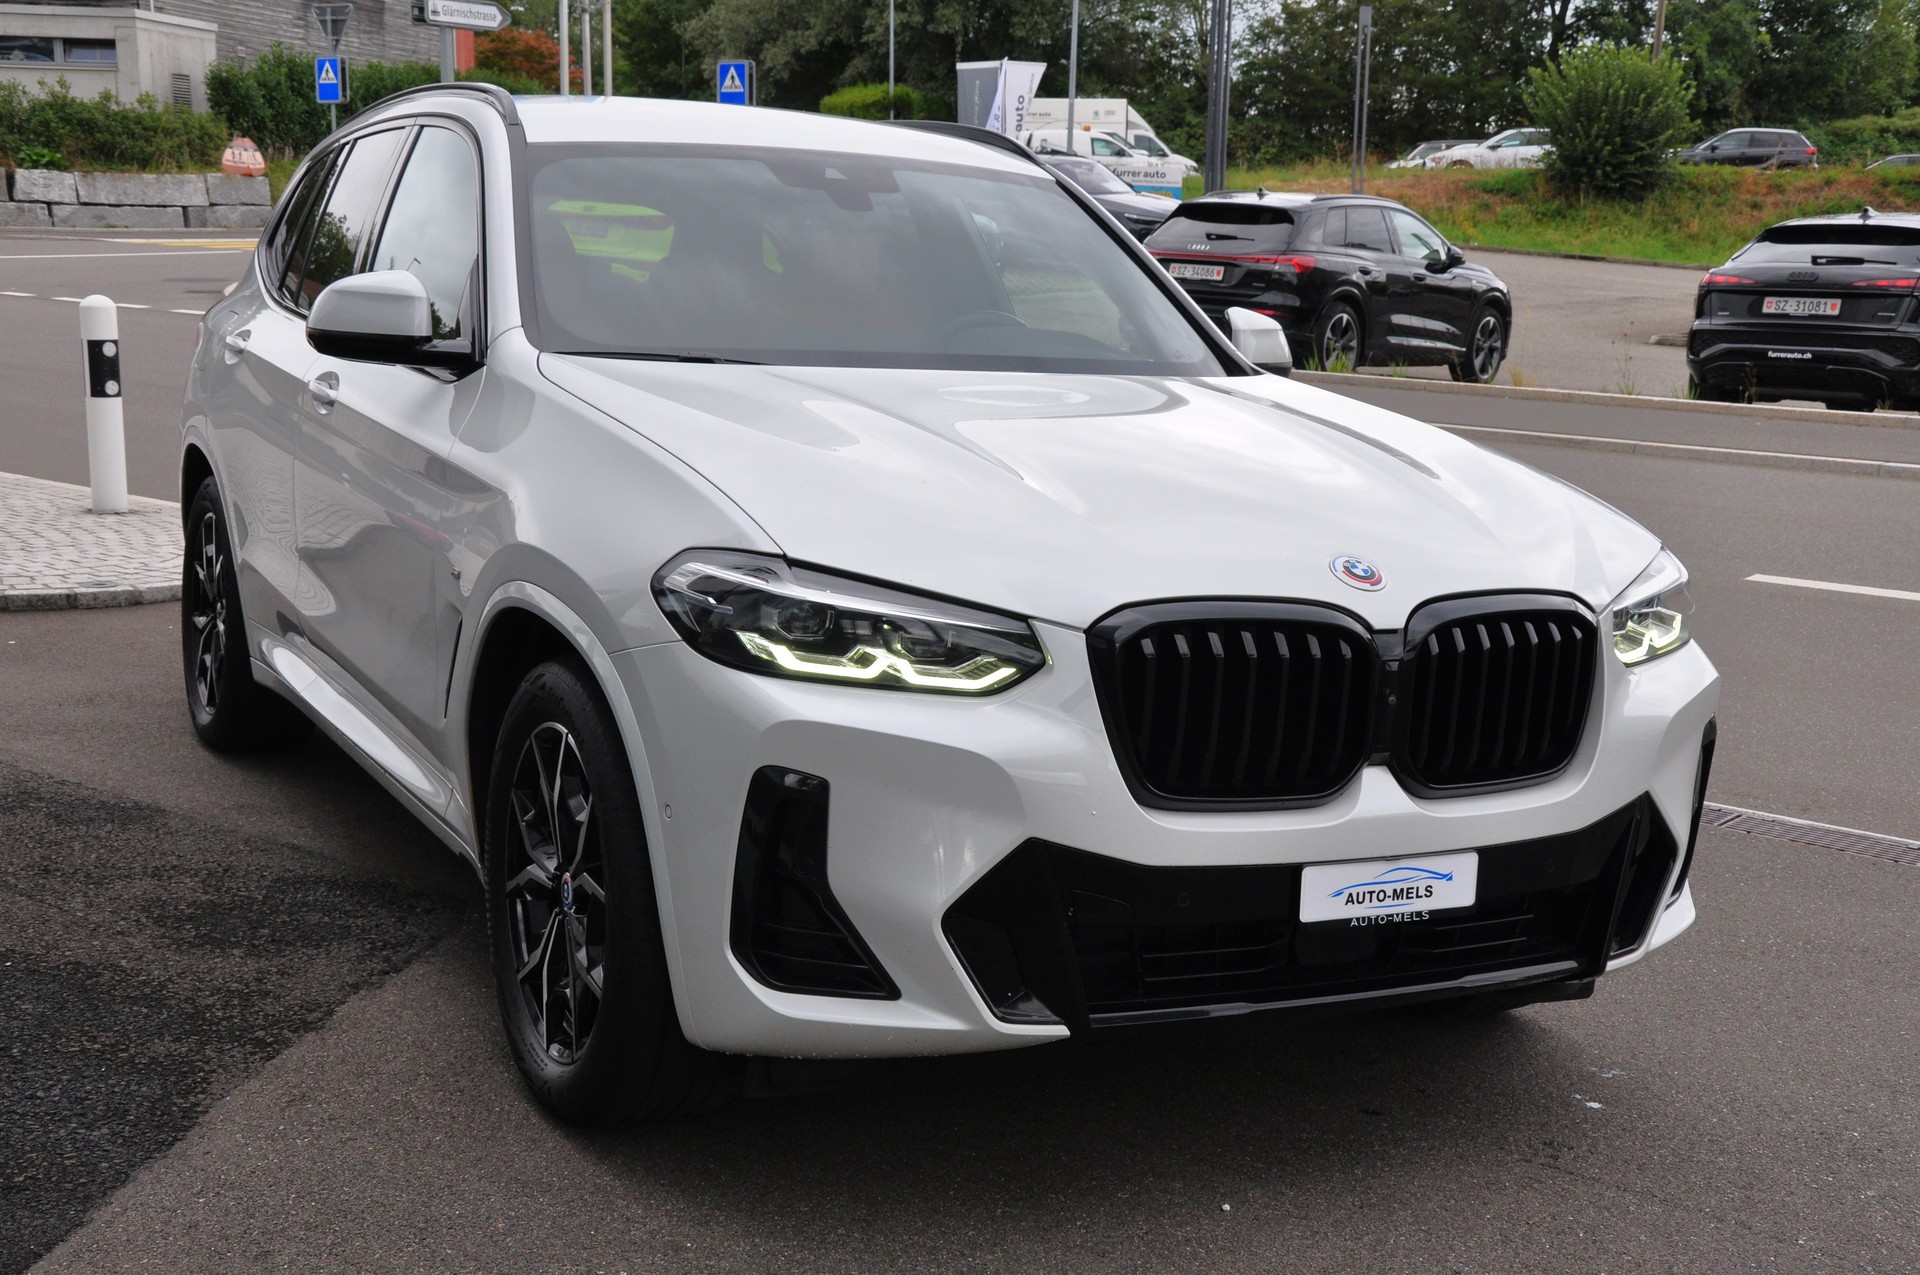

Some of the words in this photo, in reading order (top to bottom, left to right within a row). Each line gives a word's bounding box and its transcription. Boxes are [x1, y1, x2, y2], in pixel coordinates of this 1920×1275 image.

[441, 4, 497, 22] Glärnischstrasse
[1015, 95, 1025, 132] auto
[1143, 170, 1167, 179] auto
[1768, 350, 1812, 360] furrerauto.ch
[1345, 885, 1433, 906] AUTO-MELS
[1350, 910, 1430, 927] AUTO-MELS
